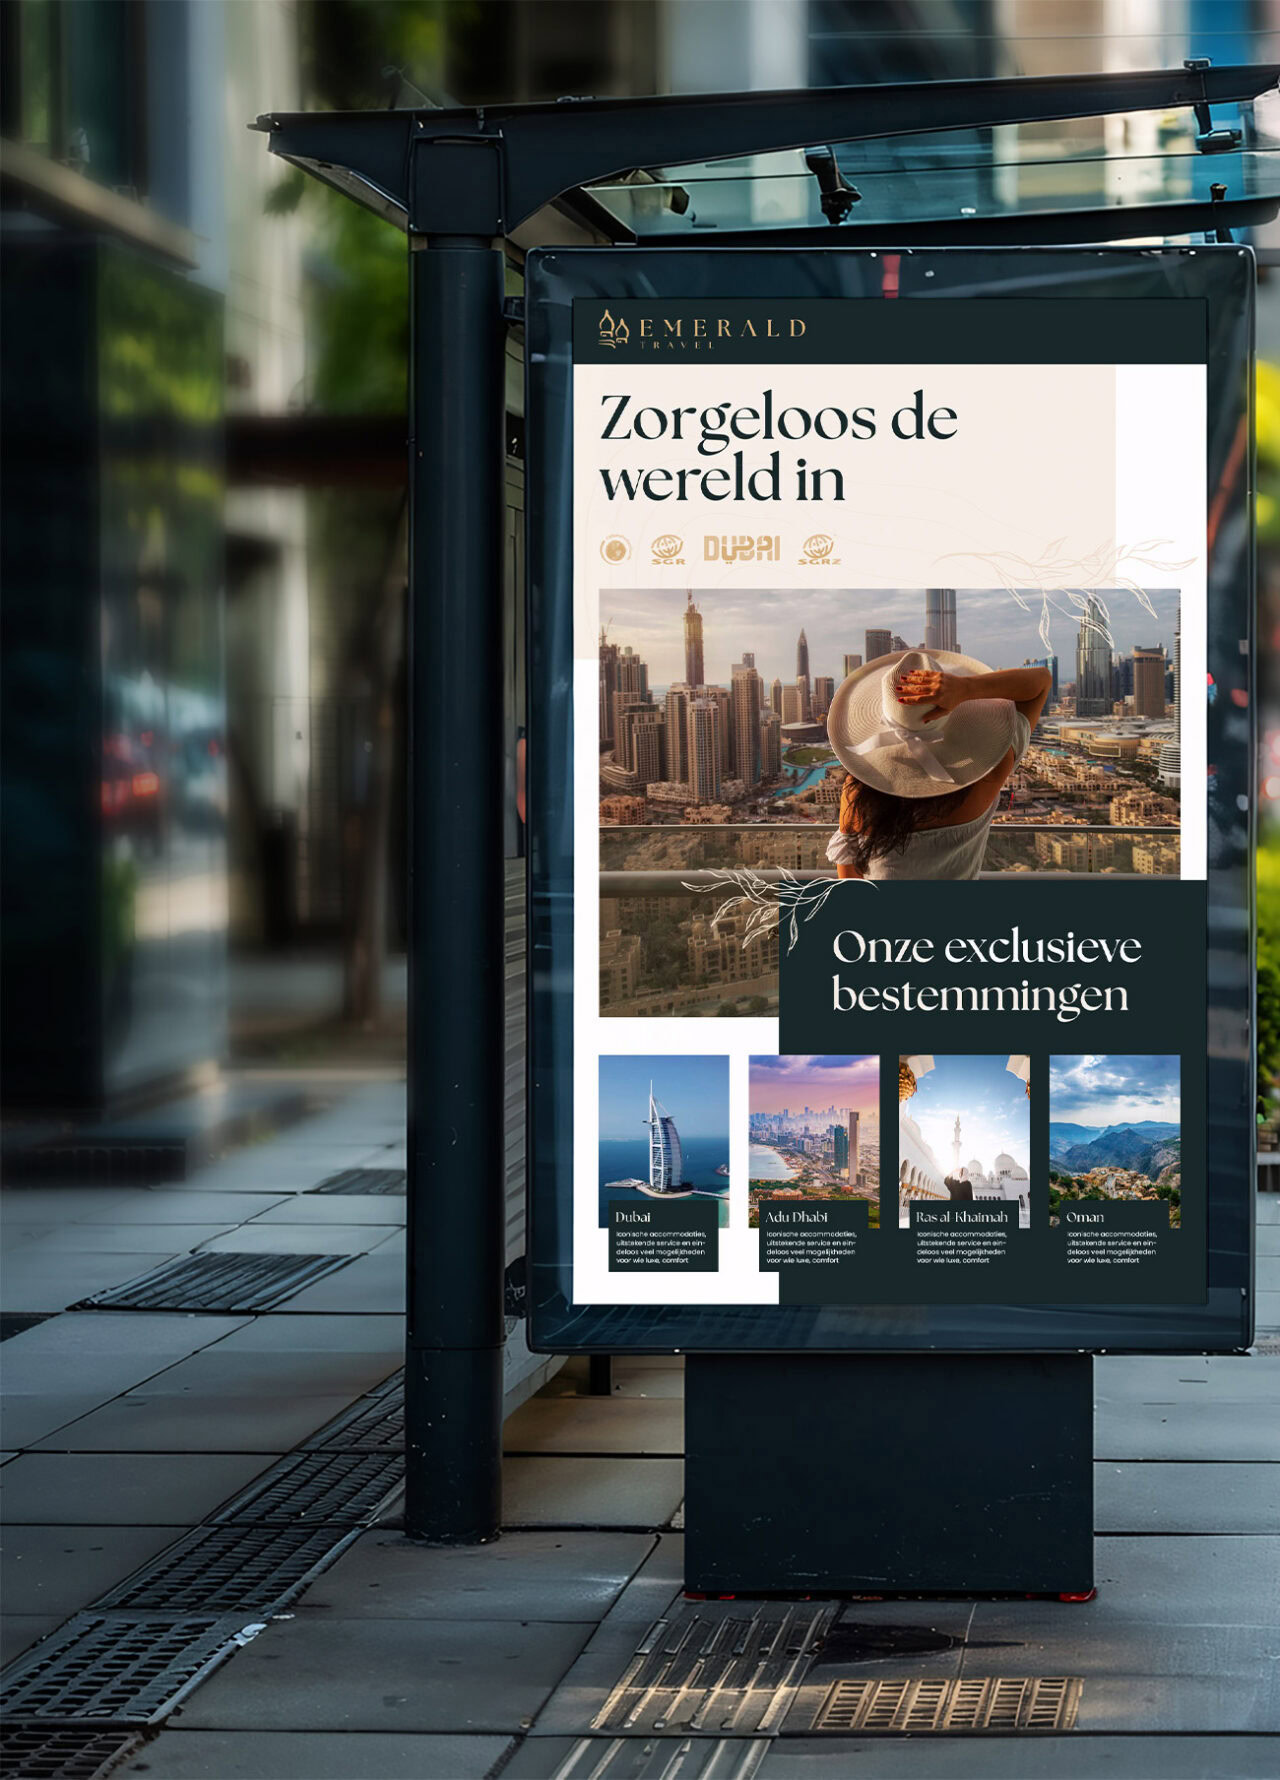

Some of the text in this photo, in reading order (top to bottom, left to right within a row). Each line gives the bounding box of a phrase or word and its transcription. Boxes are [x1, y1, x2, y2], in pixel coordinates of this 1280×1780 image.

[640, 318, 808, 338] EMERALD
[640, 340, 714, 350] TRAVEL
[601, 389, 958, 456] Zorgeloos de
[599, 450, 846, 501] wereld in
[703, 535, 781, 562] DUBAI
[651, 558, 686, 566] SGR
[833, 926, 1142, 963] Onze exclusieve
[832, 973, 1129, 1023] bestemmingen
[616, 1210, 651, 1223] Dubai
[765, 1210, 828, 1223] Adu Dhabi
[916, 1211, 938, 1223] Ras
[1066, 1211, 1105, 1223] Oman
[616, 1230, 707, 1239] Iconische accommodaties,
[767, 1230, 858, 1239] Iconische accommodaties,
[917, 1230, 1008, 1239] Iconische accommodaties,
[1067, 1230, 1158, 1239] Iconische accommodaties,
[616, 1239, 655, 1247] uitstekende
[656, 1239, 681, 1247] service
[767, 1239, 806, 1247] uitstekende
[807, 1239, 832, 1247] service
[917, 1239, 956, 1247] uitstekende
[957, 1239, 982, 1247] service
[1067, 1239, 1106, 1247] uitstekende
[1107, 1239, 1132, 1247] service
[616, 1248, 706, 1258] deloos veel mogelijkheden
[767, 1248, 857, 1258] deloos veel mogelijkheden
[917, 1248, 1007, 1258] deloos veel mogelijkheden
[1067, 1248, 1157, 1258] deloos veel mogelijkheden
